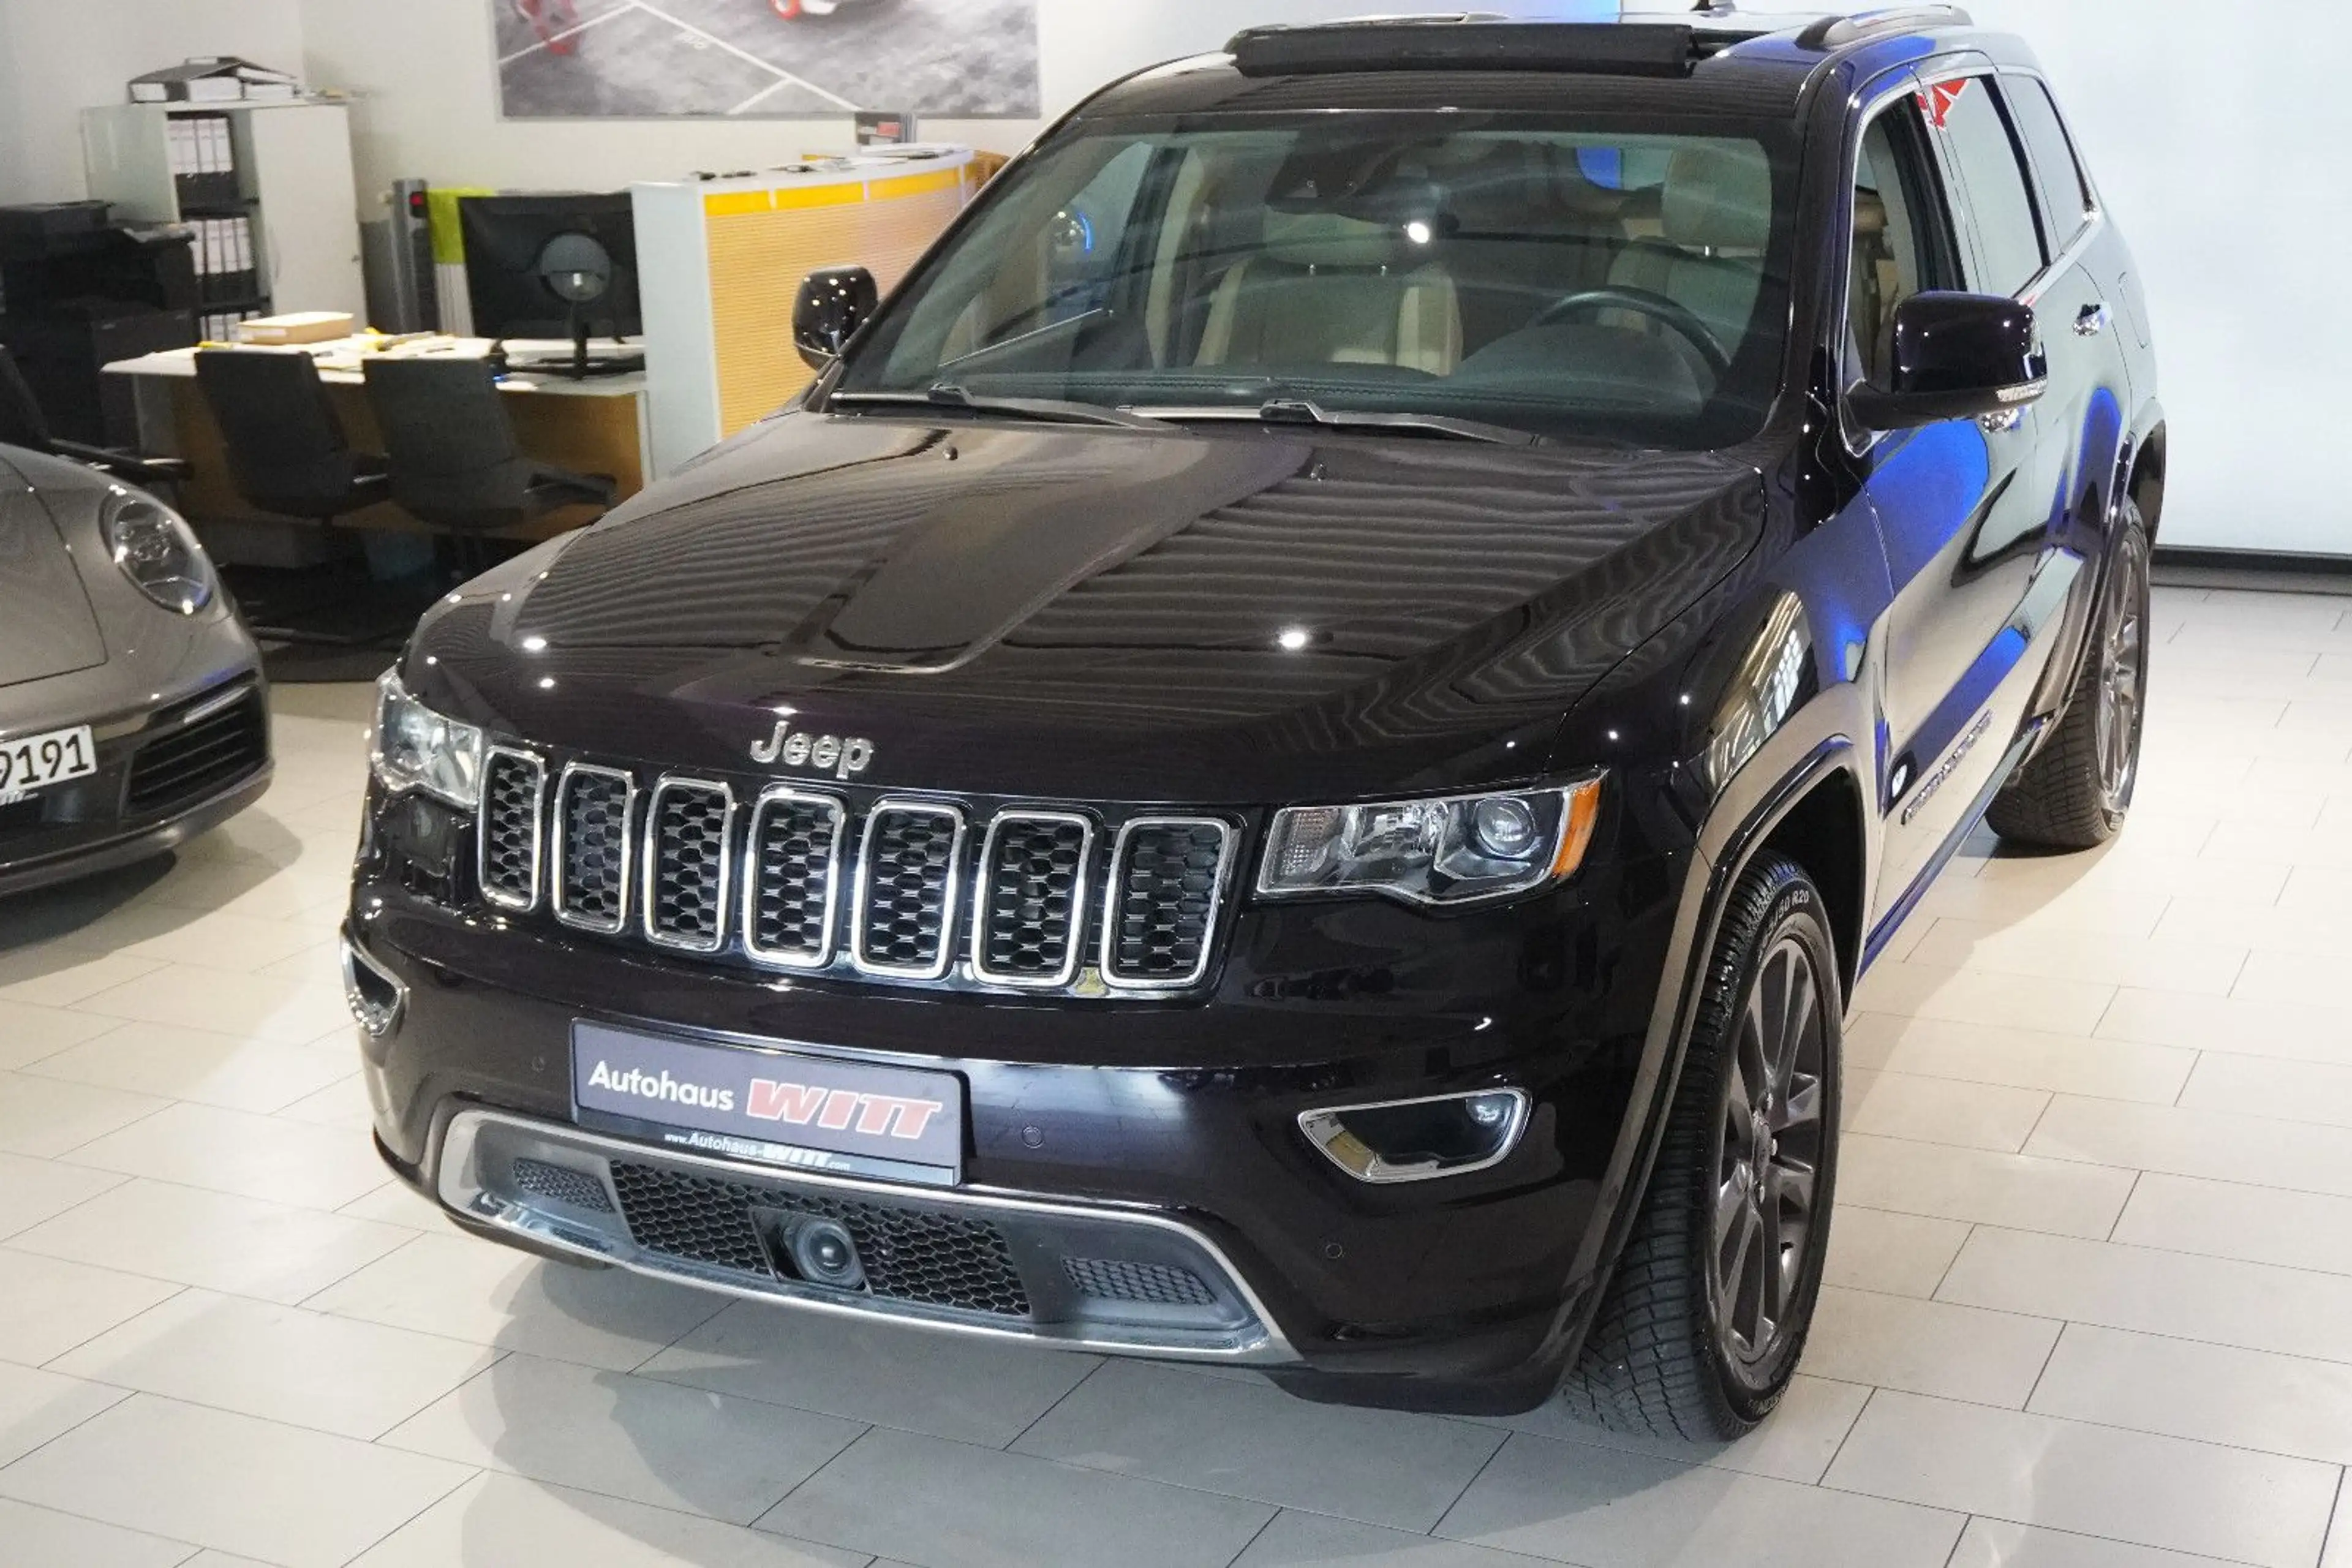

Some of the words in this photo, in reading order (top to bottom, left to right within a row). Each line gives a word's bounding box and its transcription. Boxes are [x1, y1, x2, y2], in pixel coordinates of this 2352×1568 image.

[750, 720, 874, 780] Jeep
[1792, 889, 1810, 907] R20
[588, 1060, 734, 1111] Autohaus
[747, 1078, 943, 1140] WITT
